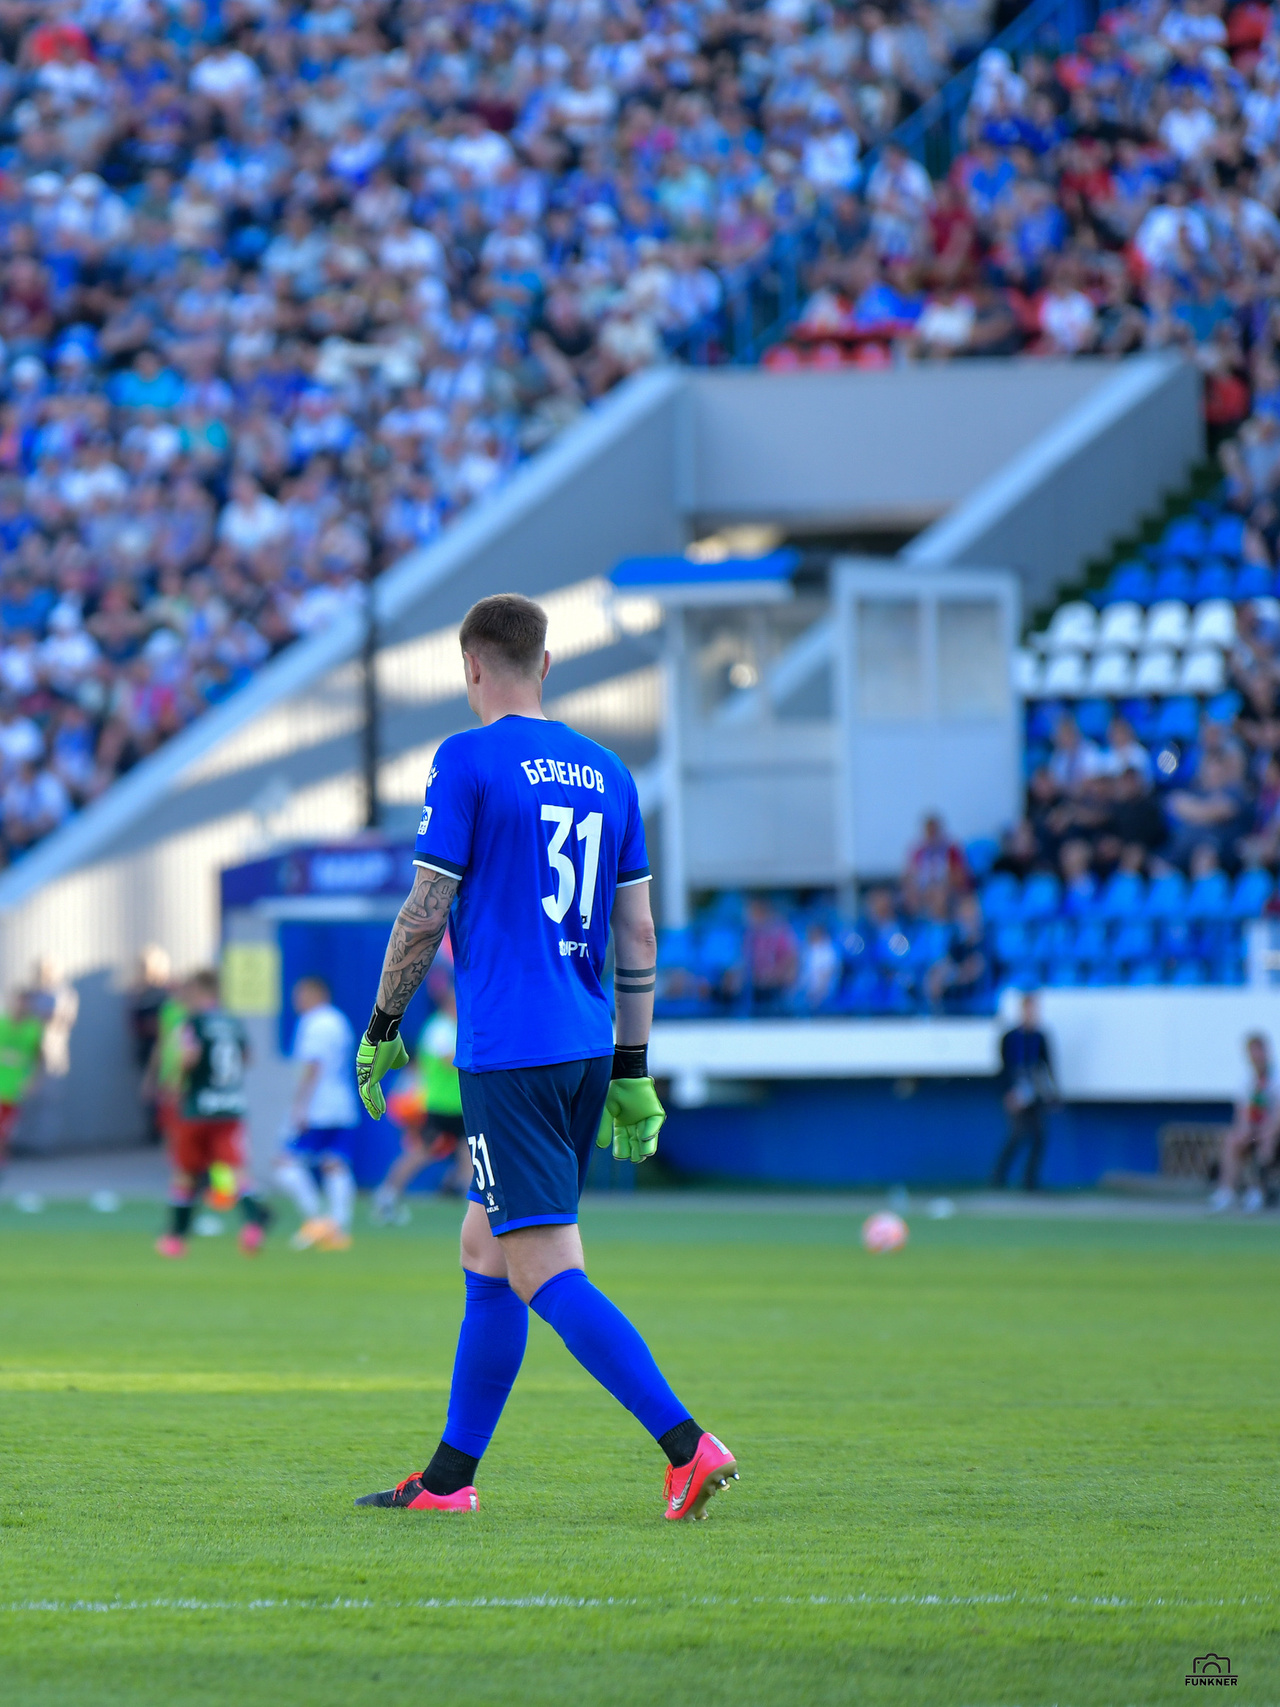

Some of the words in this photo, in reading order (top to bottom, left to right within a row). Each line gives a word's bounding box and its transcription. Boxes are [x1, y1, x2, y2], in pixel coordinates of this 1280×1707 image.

[520, 758, 605, 794] БЕЛЕНОВ
[540, 804, 604, 930] 31
[467, 1132, 495, 1191] 31
